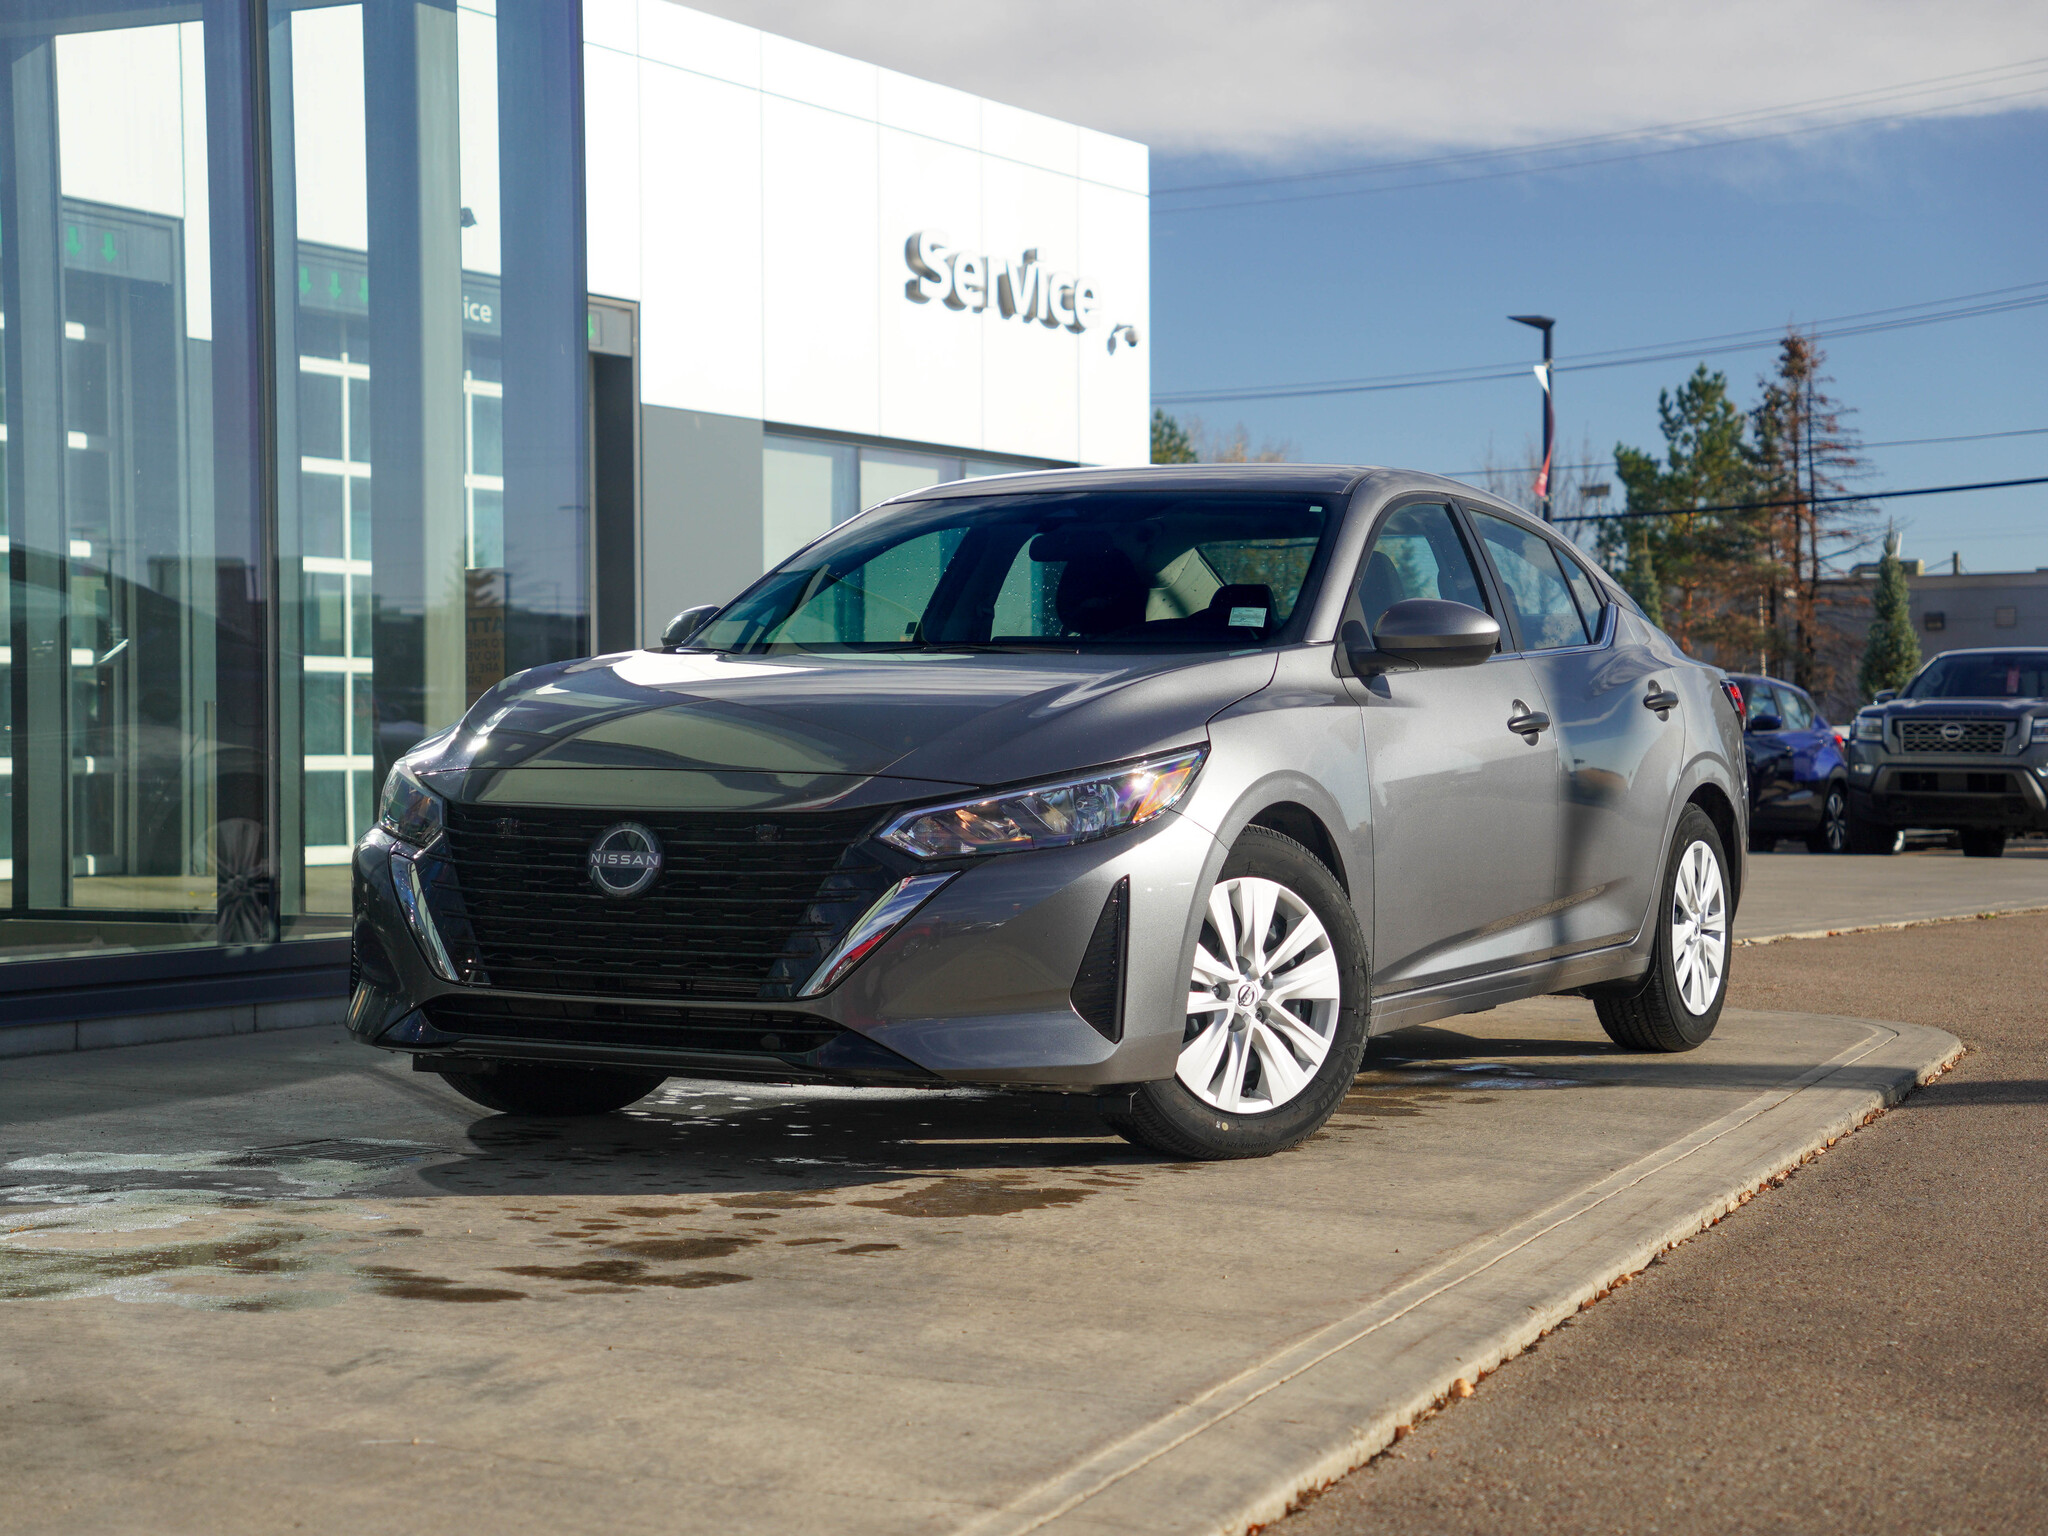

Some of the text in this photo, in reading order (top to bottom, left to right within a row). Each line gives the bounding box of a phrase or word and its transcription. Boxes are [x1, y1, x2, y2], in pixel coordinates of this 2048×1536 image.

[905, 230, 1102, 334] Service
[463, 296, 493, 323] ice
[590, 853, 659, 866] NISSAN
